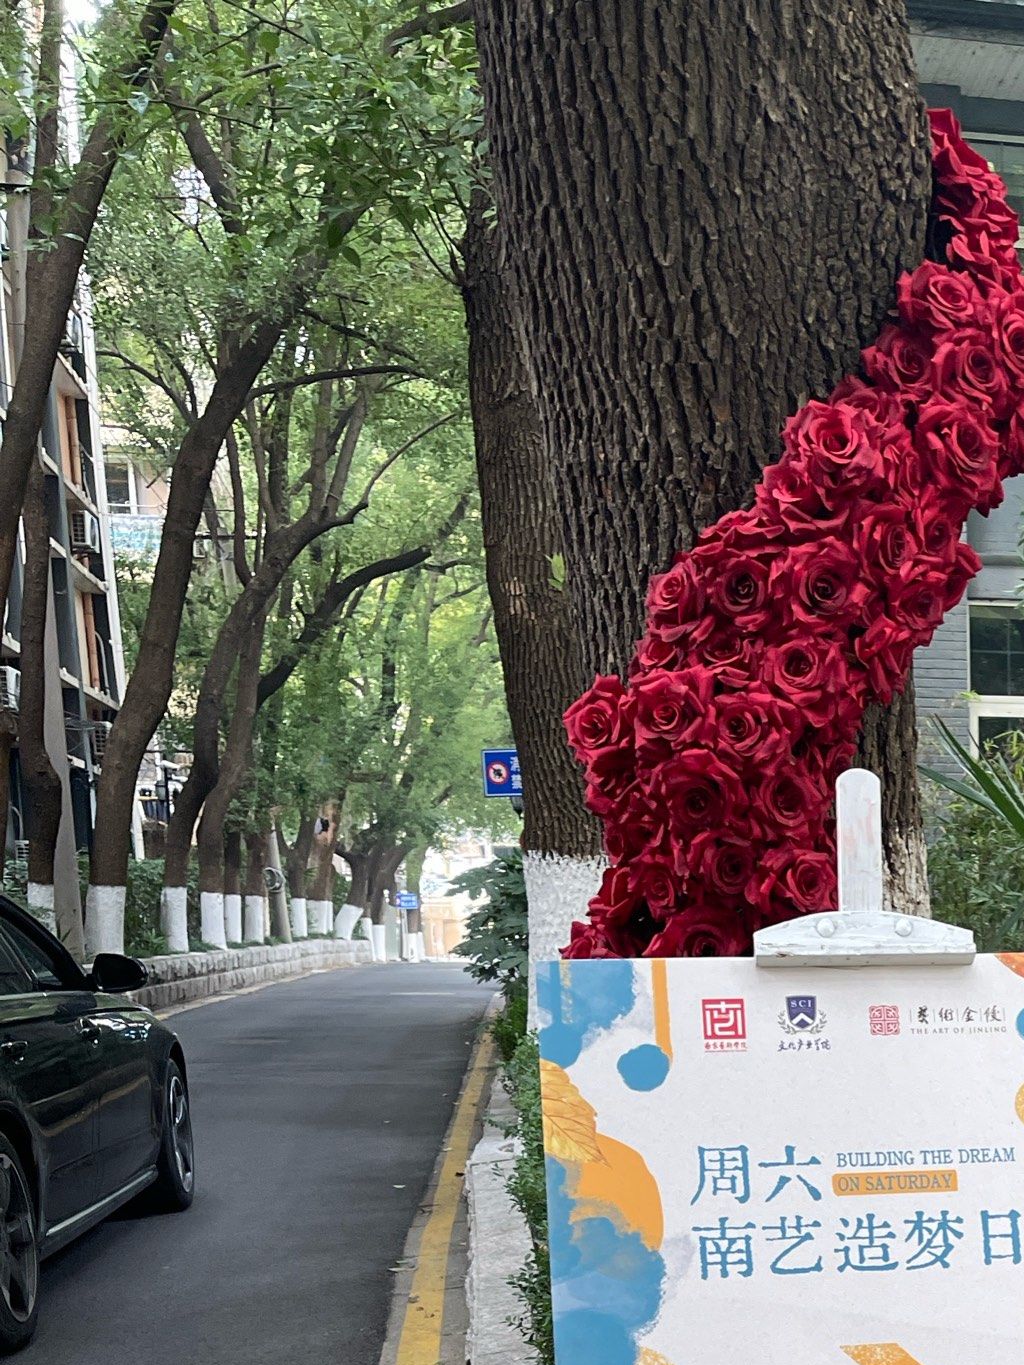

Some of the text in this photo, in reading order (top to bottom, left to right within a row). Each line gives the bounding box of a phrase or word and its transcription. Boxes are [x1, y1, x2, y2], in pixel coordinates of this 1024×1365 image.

[790, 999, 812, 1008] SCI
[969, 1026, 1007, 1034] JINLING
[836, 1147, 1016, 1168] BUILDING THE DREAM
[690, 1144, 823, 1206] 周六
[837, 1172, 953, 1192] ON SATURDAY
[691, 1209, 1023, 1281] 南艺造梦日
